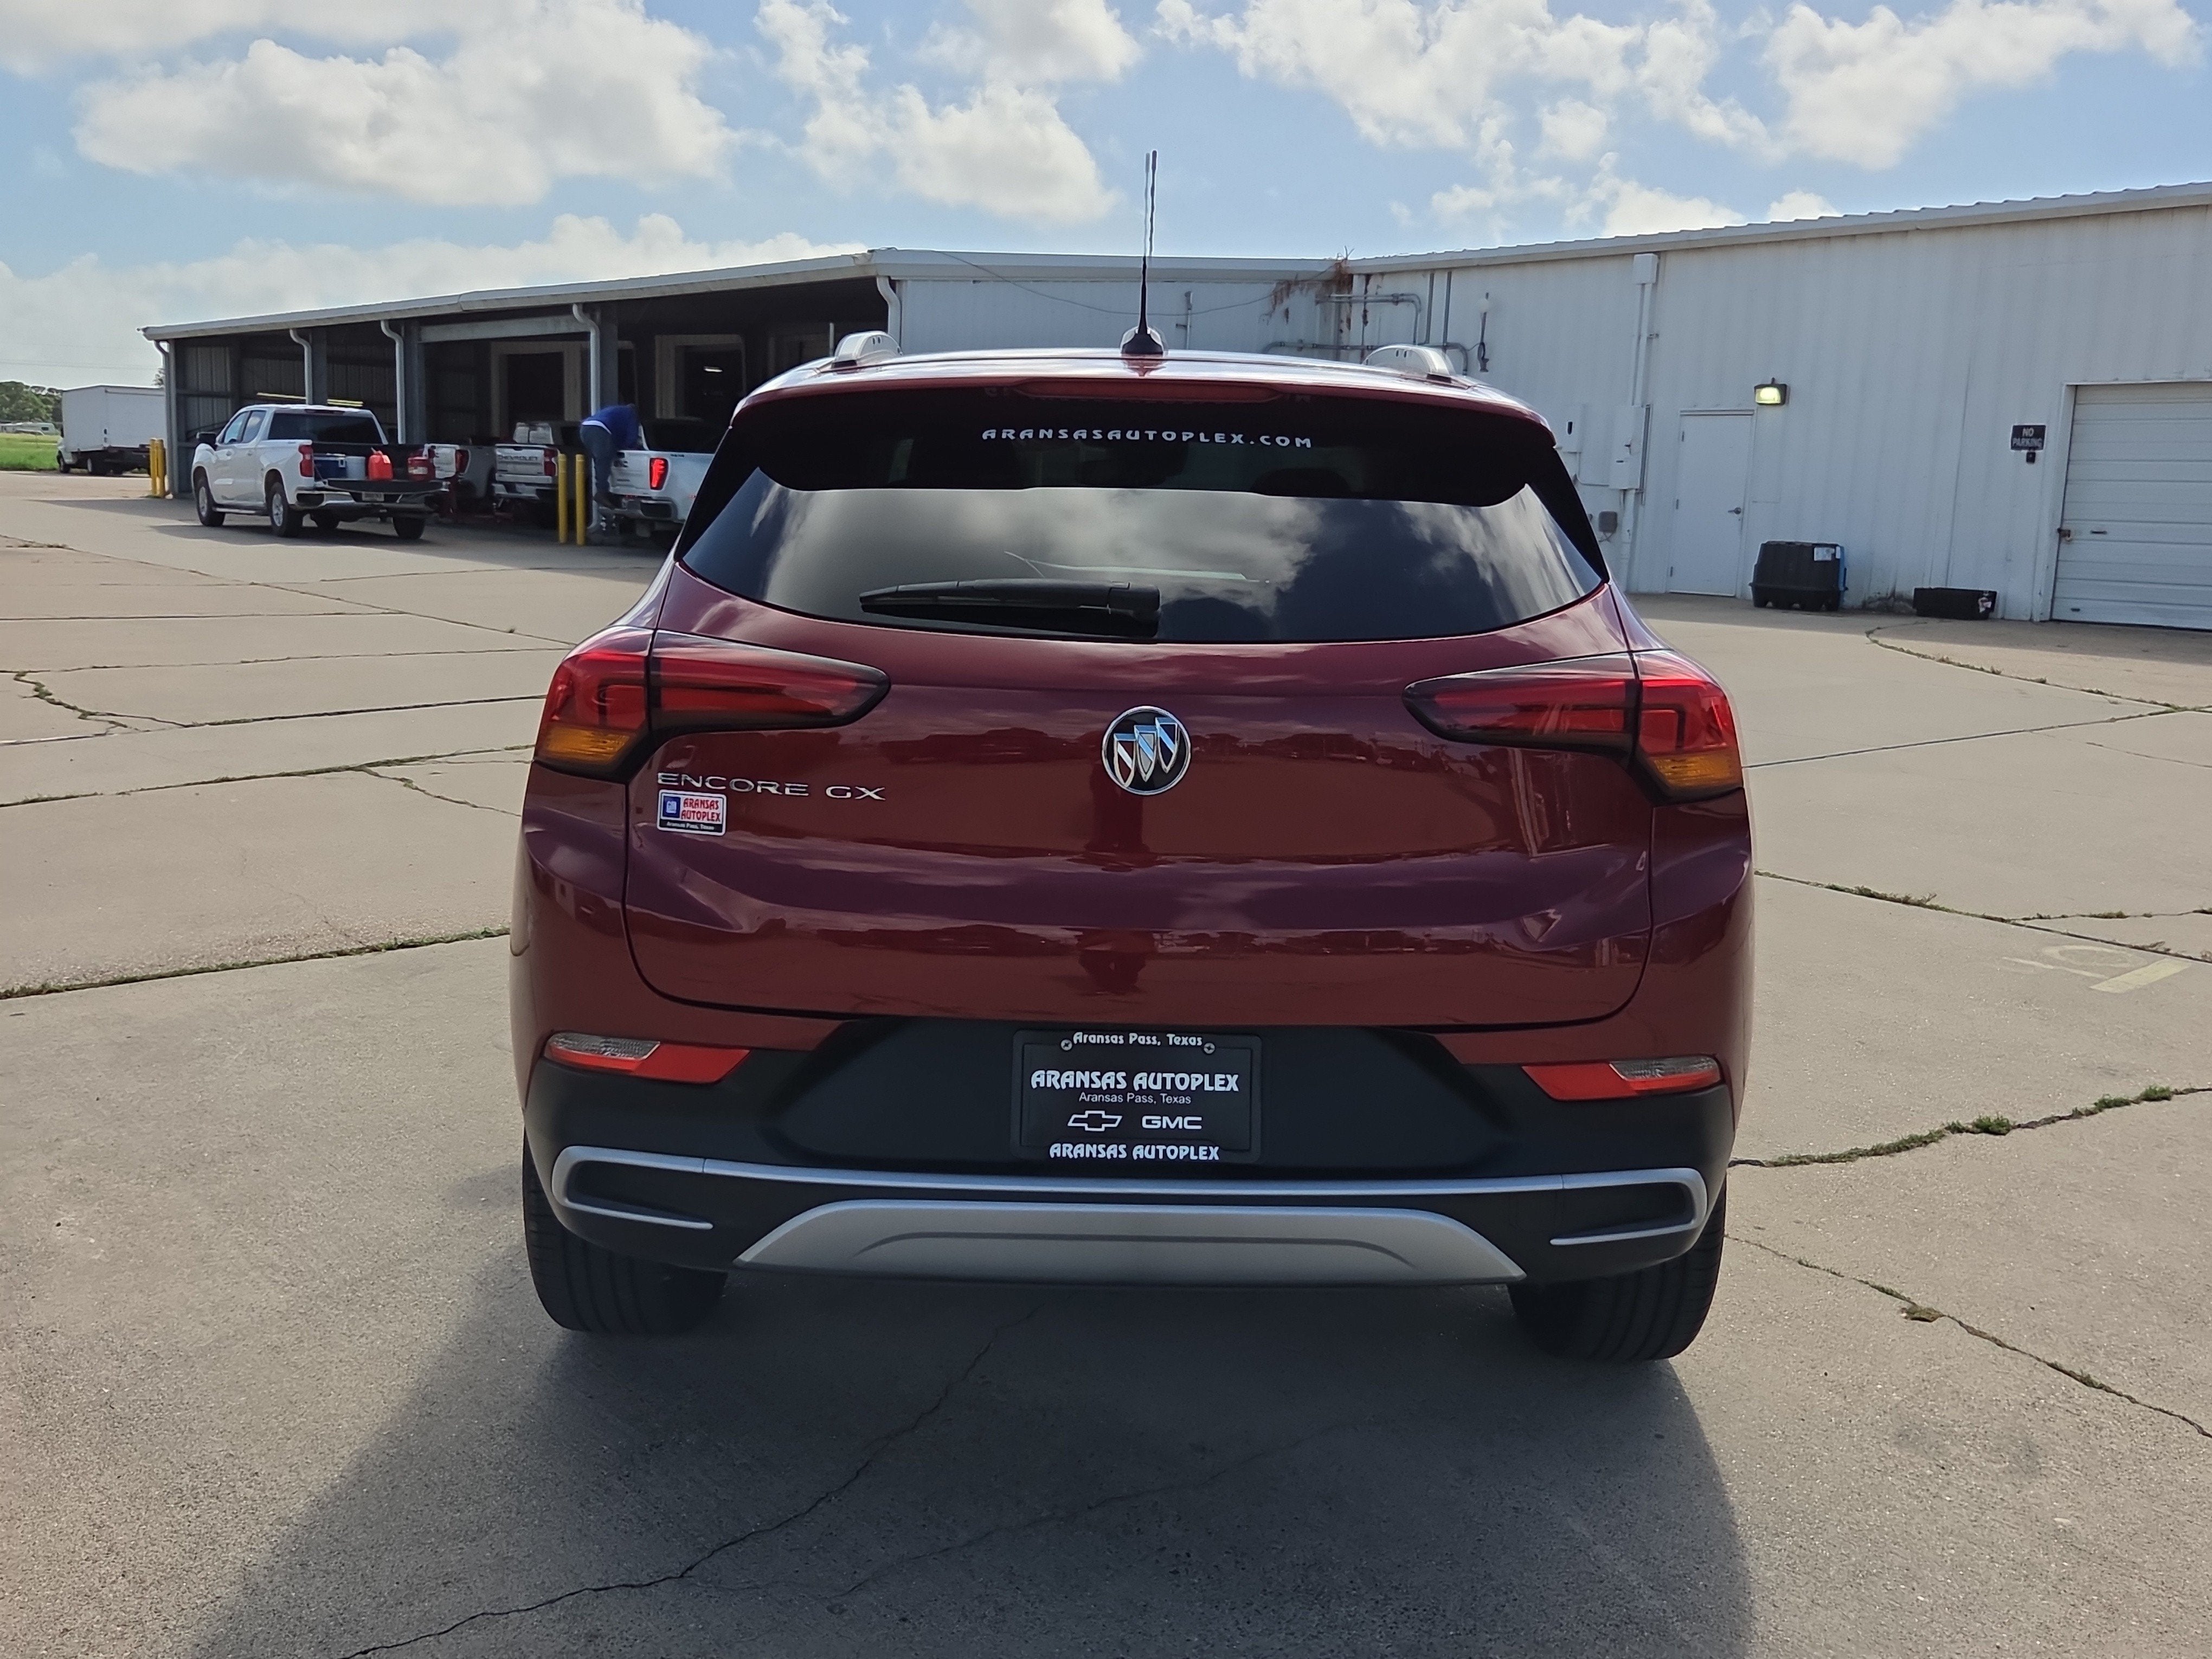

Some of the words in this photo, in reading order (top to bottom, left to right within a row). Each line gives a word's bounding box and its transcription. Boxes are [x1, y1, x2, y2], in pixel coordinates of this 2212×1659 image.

[982, 428, 1312, 449] ARANSASAUTOPLEX.COM
[2022, 427, 2034, 437] NO
[658, 772, 809, 796] ENCORE
[826, 786, 886, 801] GX
[683, 798, 719, 810] ARANSAS
[681, 809, 721, 822] AUTOPLEX
[1073, 1032, 1124, 1044] Aransas
[1129, 1033, 1161, 1046] Pass,
[1166, 1033, 1203, 1046] Texas
[1031, 1070, 1127, 1090] ARANSAS
[1133, 1072, 1239, 1091] AUTOPLEX
[1079, 1092, 1123, 1103] Aransas
[1127, 1092, 1156, 1104] Pass,
[1160, 1093, 1191, 1104] Texas
[1141, 1115, 1203, 1129] GMC
[1049, 1143, 1127, 1159] ARANSAS
[1132, 1144, 1220, 1161] AUTOPLEX
